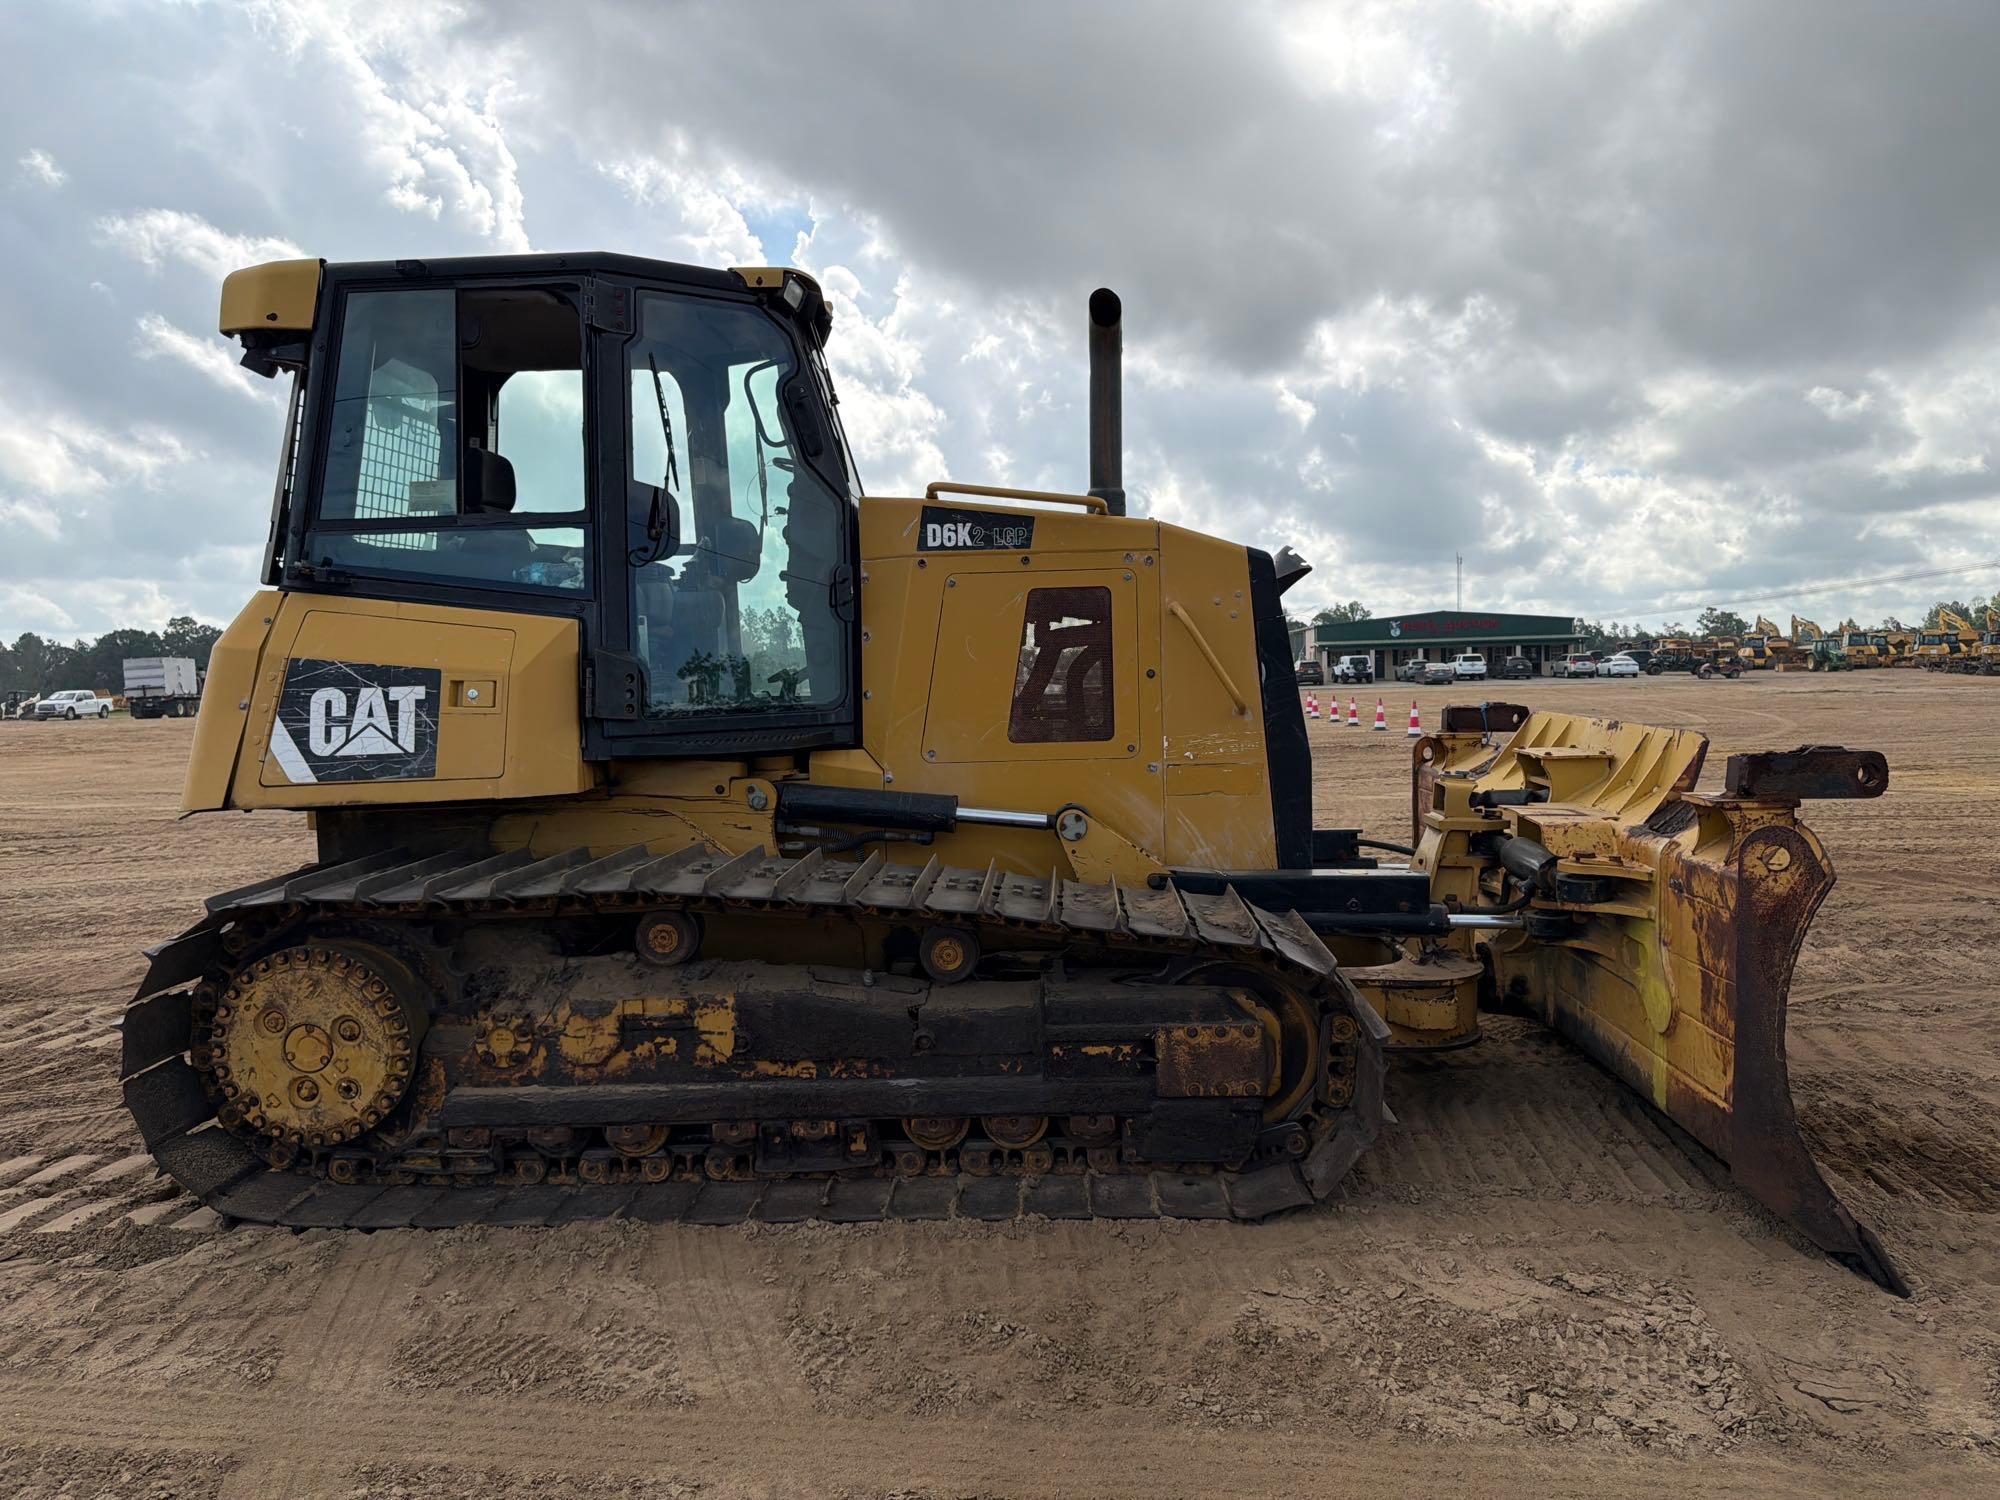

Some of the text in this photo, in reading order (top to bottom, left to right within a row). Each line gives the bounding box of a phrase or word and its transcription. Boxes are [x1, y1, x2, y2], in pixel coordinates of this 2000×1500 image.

[926, 522, 1027, 547] D6K2 LGP
[309, 685, 426, 757] CAT
